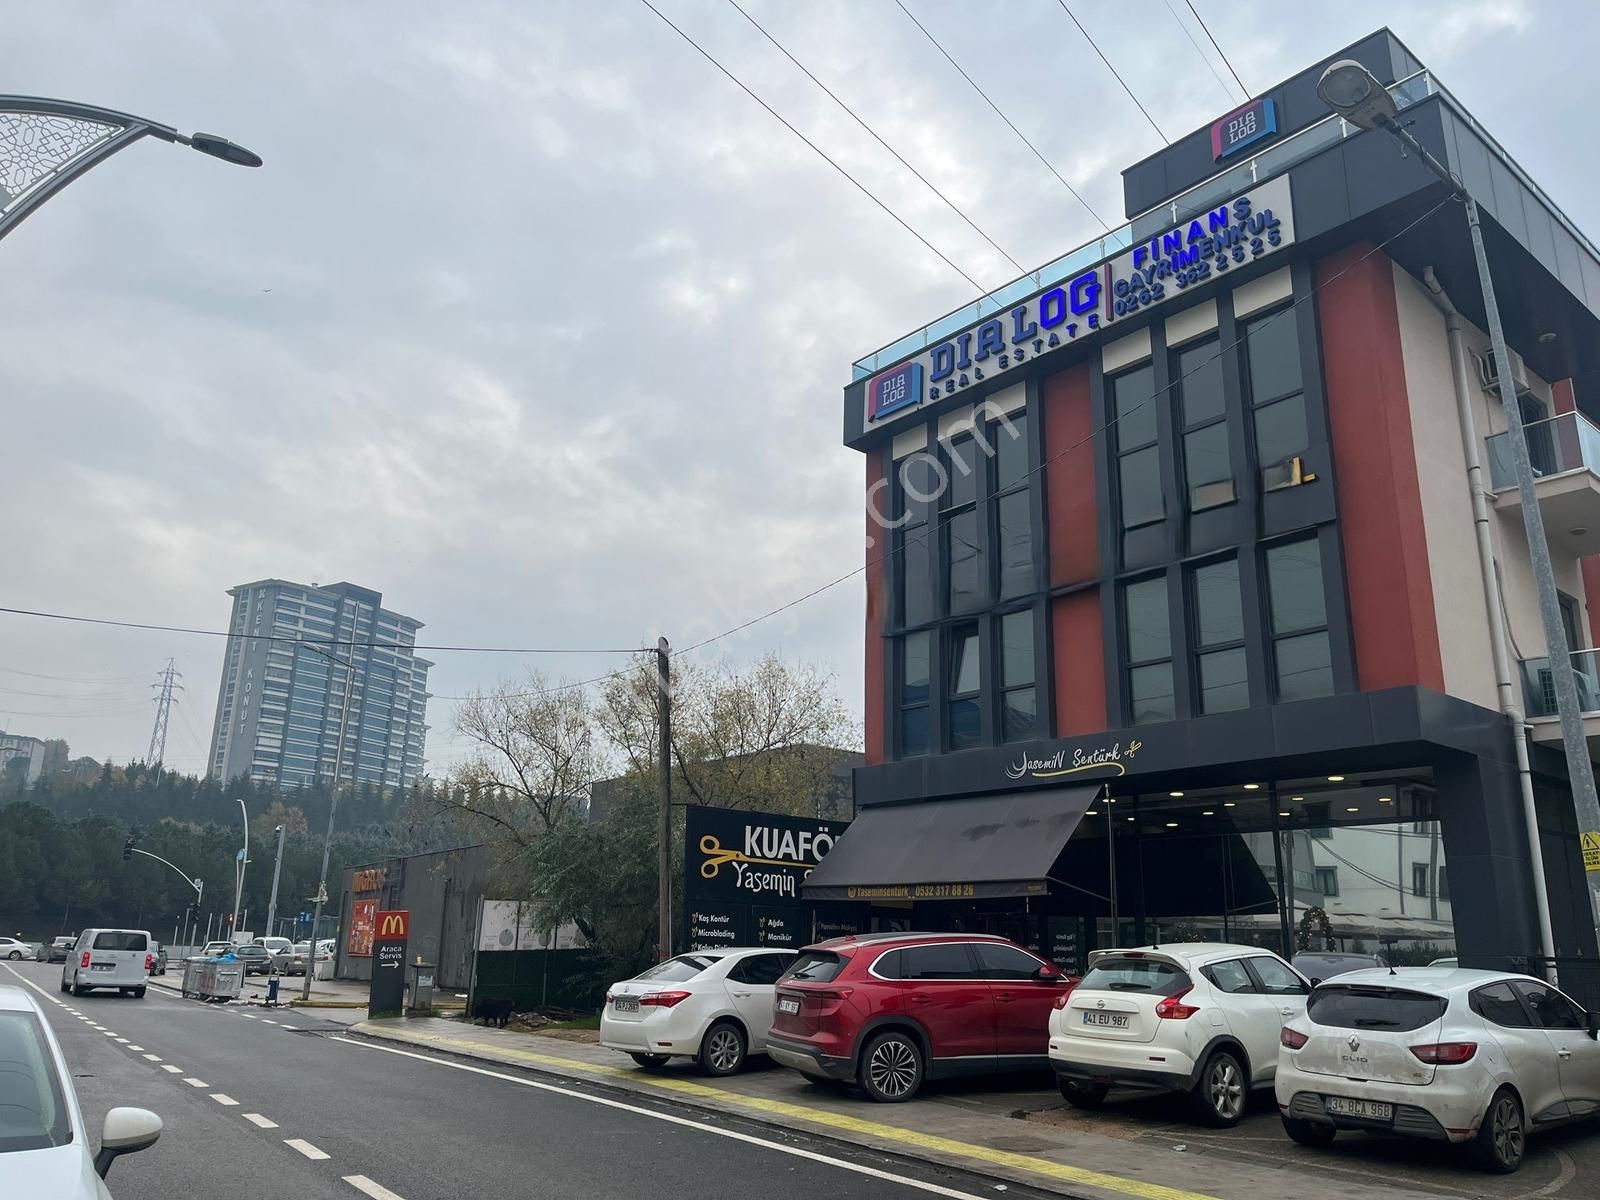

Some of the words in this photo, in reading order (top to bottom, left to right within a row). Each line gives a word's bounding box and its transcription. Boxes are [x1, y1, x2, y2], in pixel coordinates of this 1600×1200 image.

[1229, 111, 1256, 134] DIA
[1229, 121, 1257, 145] LOG
[1114, 282, 1166, 316] 0262
[930, 270, 1102, 383] DIALOG
[929, 367, 985, 401] REAL
[998, 312, 1101, 370] ESTATE
[882, 373, 906, 394] DIA
[882, 385, 906, 406] LOG
[744, 825, 843, 862] KUAFÖ
[731, 861, 796, 898] Yasemin
[915, 886, 934, 897] 0532
[935, 885, 950, 897] 317
[698, 914, 709, 924] Kaş
[767, 919, 784, 928] Ağda
[697, 928, 735, 939] Microblading
[767, 933, 793, 941] Manikür
[1087, 1012, 1096, 1024] 41
[1098, 1014, 1109, 1025] EU
[1112, 1016, 1128, 1027] 987
[1342, 1055, 1368, 1063] CLIO
[1332, 1098, 1344, 1111] 34
[1348, 1100, 1367, 1114] BCA
